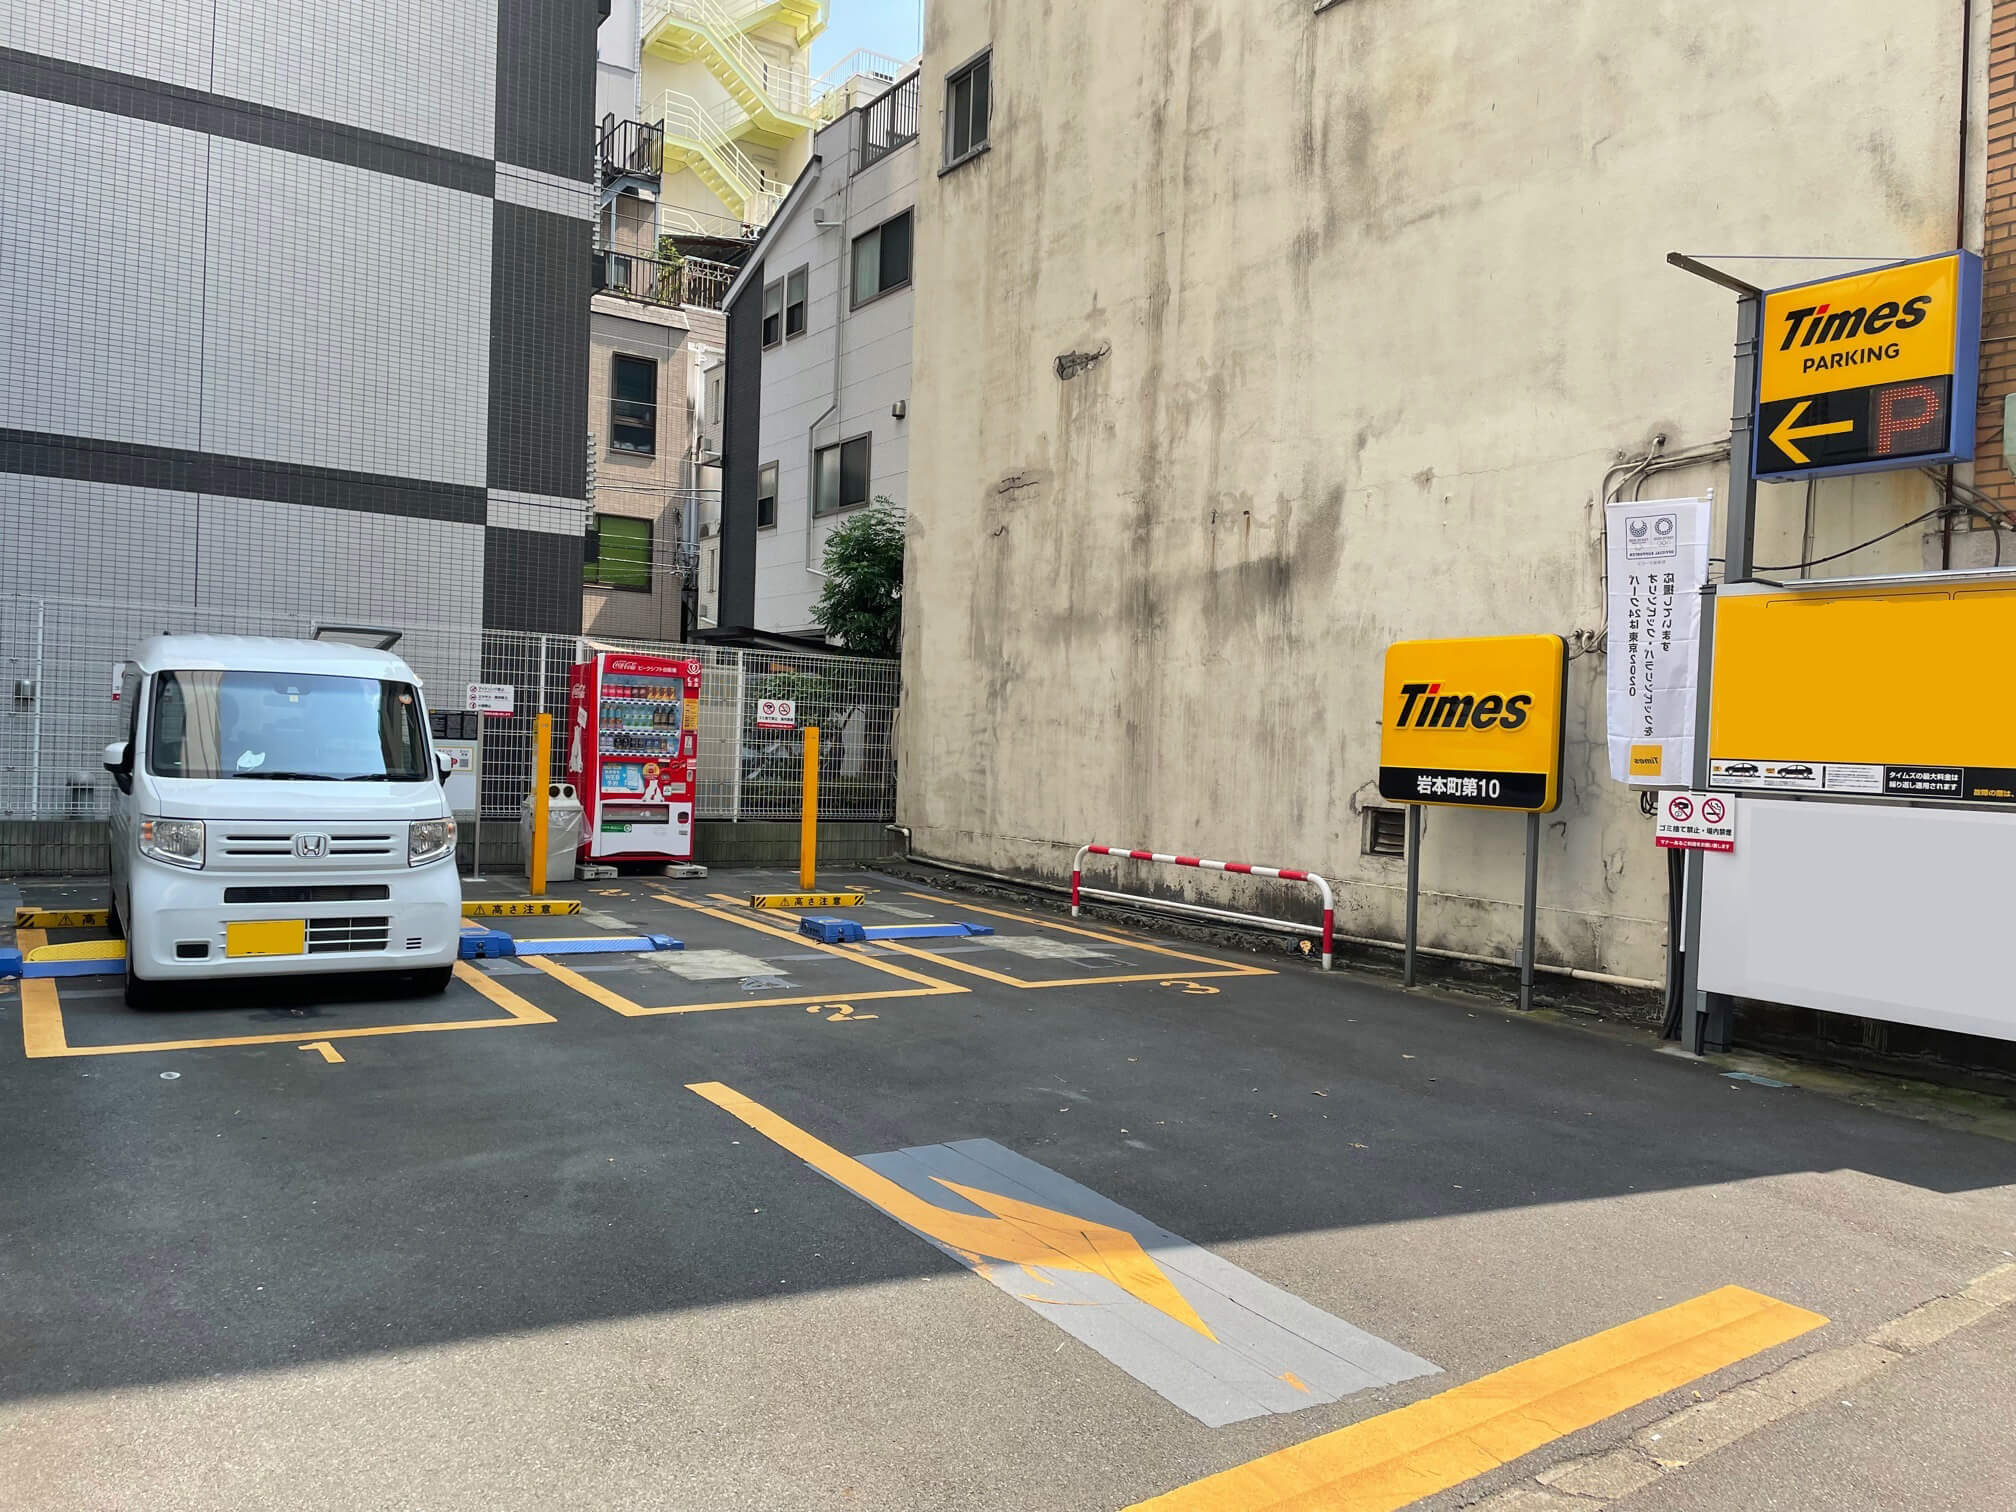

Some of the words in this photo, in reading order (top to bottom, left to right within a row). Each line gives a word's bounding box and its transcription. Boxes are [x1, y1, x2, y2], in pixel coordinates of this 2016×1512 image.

[1780, 295, 1932, 352] Times
[1802, 342, 1900, 374] PARKING
[1877, 384, 1940, 455] P
[1396, 683, 1532, 729] Times
[1417, 775, 1501, 798] 岩本町第10
[492, 904, 551, 915] 高さ注意
[794, 895, 842, 906] 高さ注意
[1159, 980, 1221, 995] 3
[806, 1003, 880, 1022] 2
[298, 1041, 346, 1064] 1
